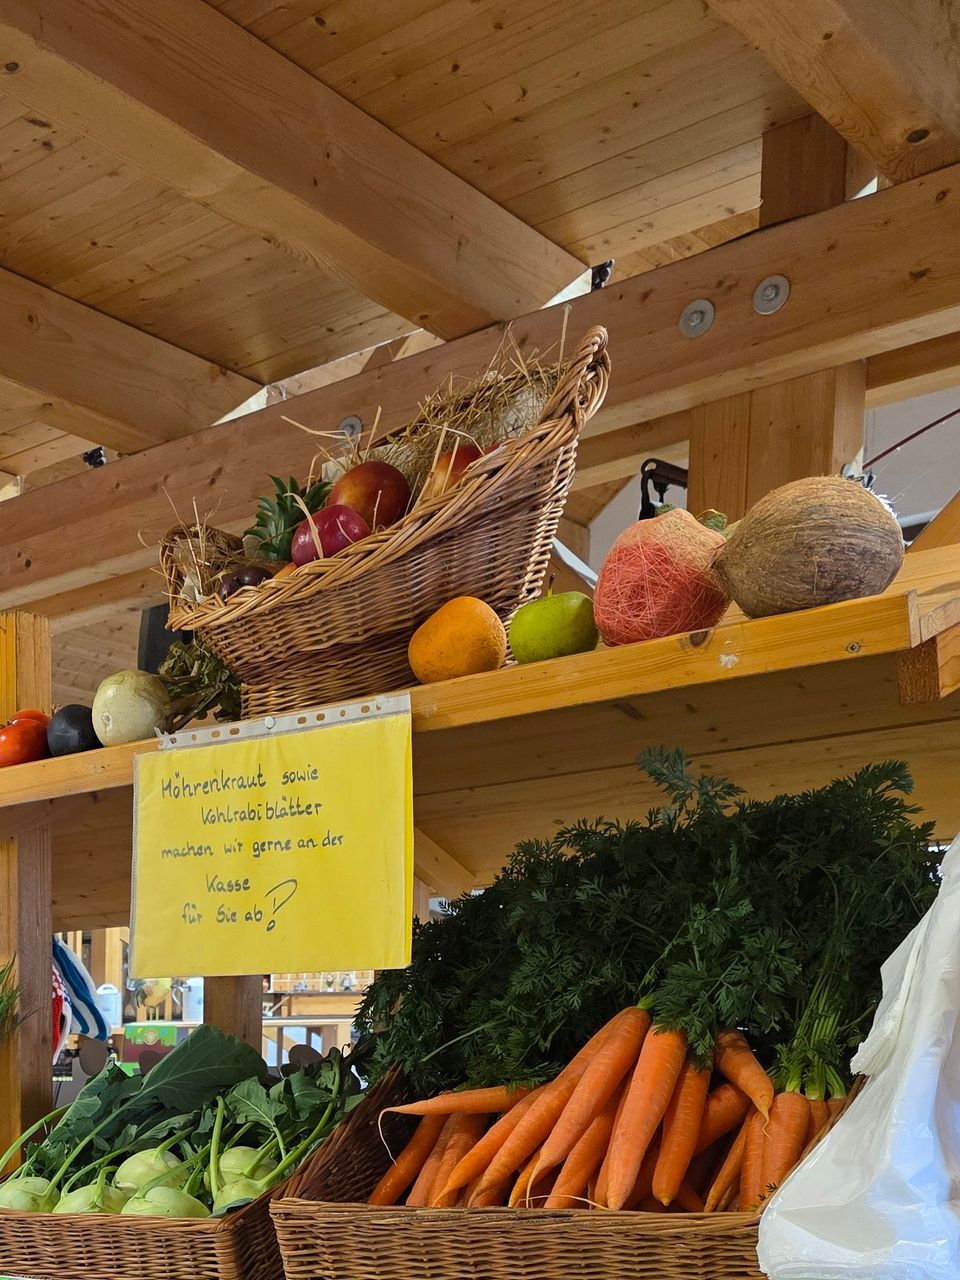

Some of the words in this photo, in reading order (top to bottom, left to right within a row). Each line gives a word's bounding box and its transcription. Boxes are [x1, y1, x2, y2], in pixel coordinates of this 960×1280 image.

[161, 764, 267, 799] Möhrenkraut
[281, 764, 319, 786] sowie
[161, 842, 214, 859] machen
[224, 837, 243, 854] wir
[252, 838, 291, 858] gerne
[297, 838, 317, 849] an
[322, 829, 344, 848] der
[206, 873, 251, 893] Kasse
[182, 902, 203, 924] für
[216, 903, 237, 923] Sie
